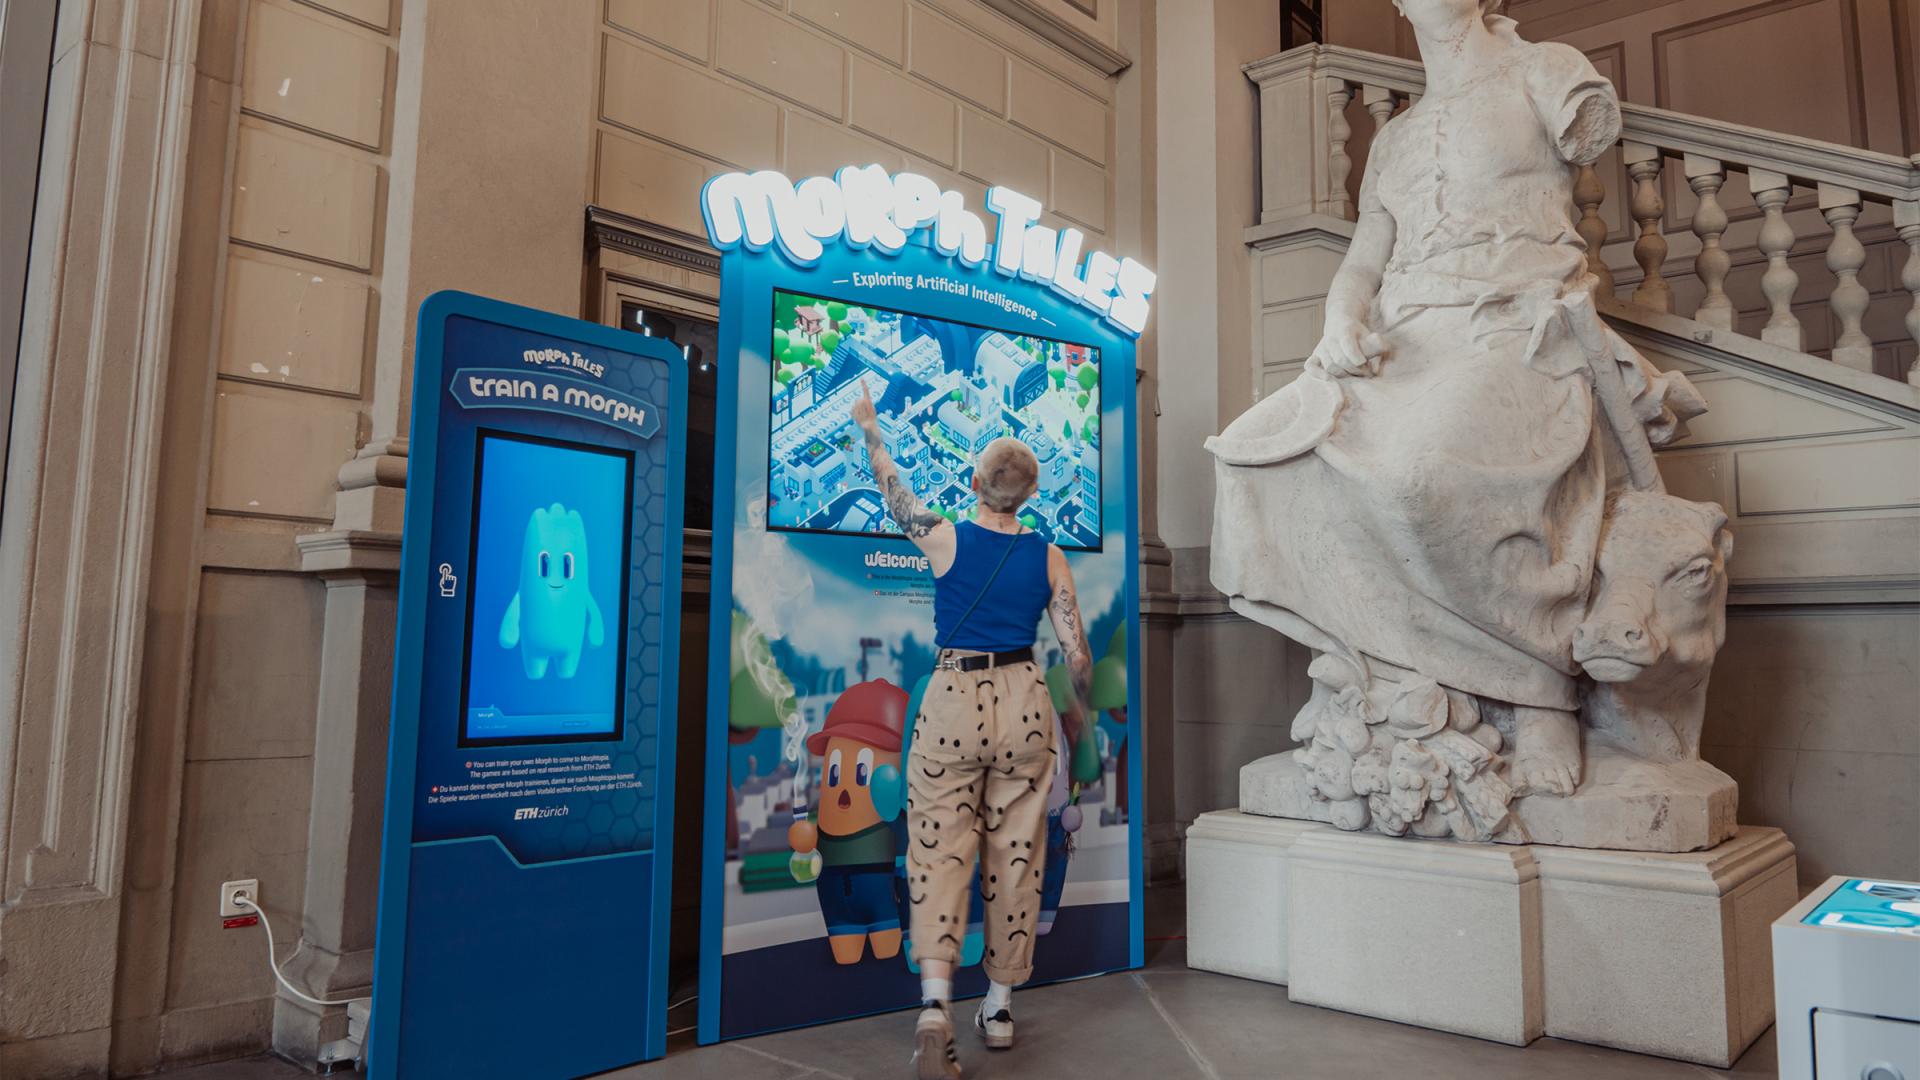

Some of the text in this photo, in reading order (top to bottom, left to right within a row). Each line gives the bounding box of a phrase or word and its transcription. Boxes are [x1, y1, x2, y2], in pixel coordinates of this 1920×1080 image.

[852, 272, 1038, 321] Exploring Artificial Intelligence
[473, 760, 485, 768] You
[509, 760, 522, 768] your
[470, 770, 481, 778] The
[481, 770, 501, 779] games
[511, 768, 528, 776] based
[583, 763, 594, 771] ETH
[439, 785, 449, 793] Du
